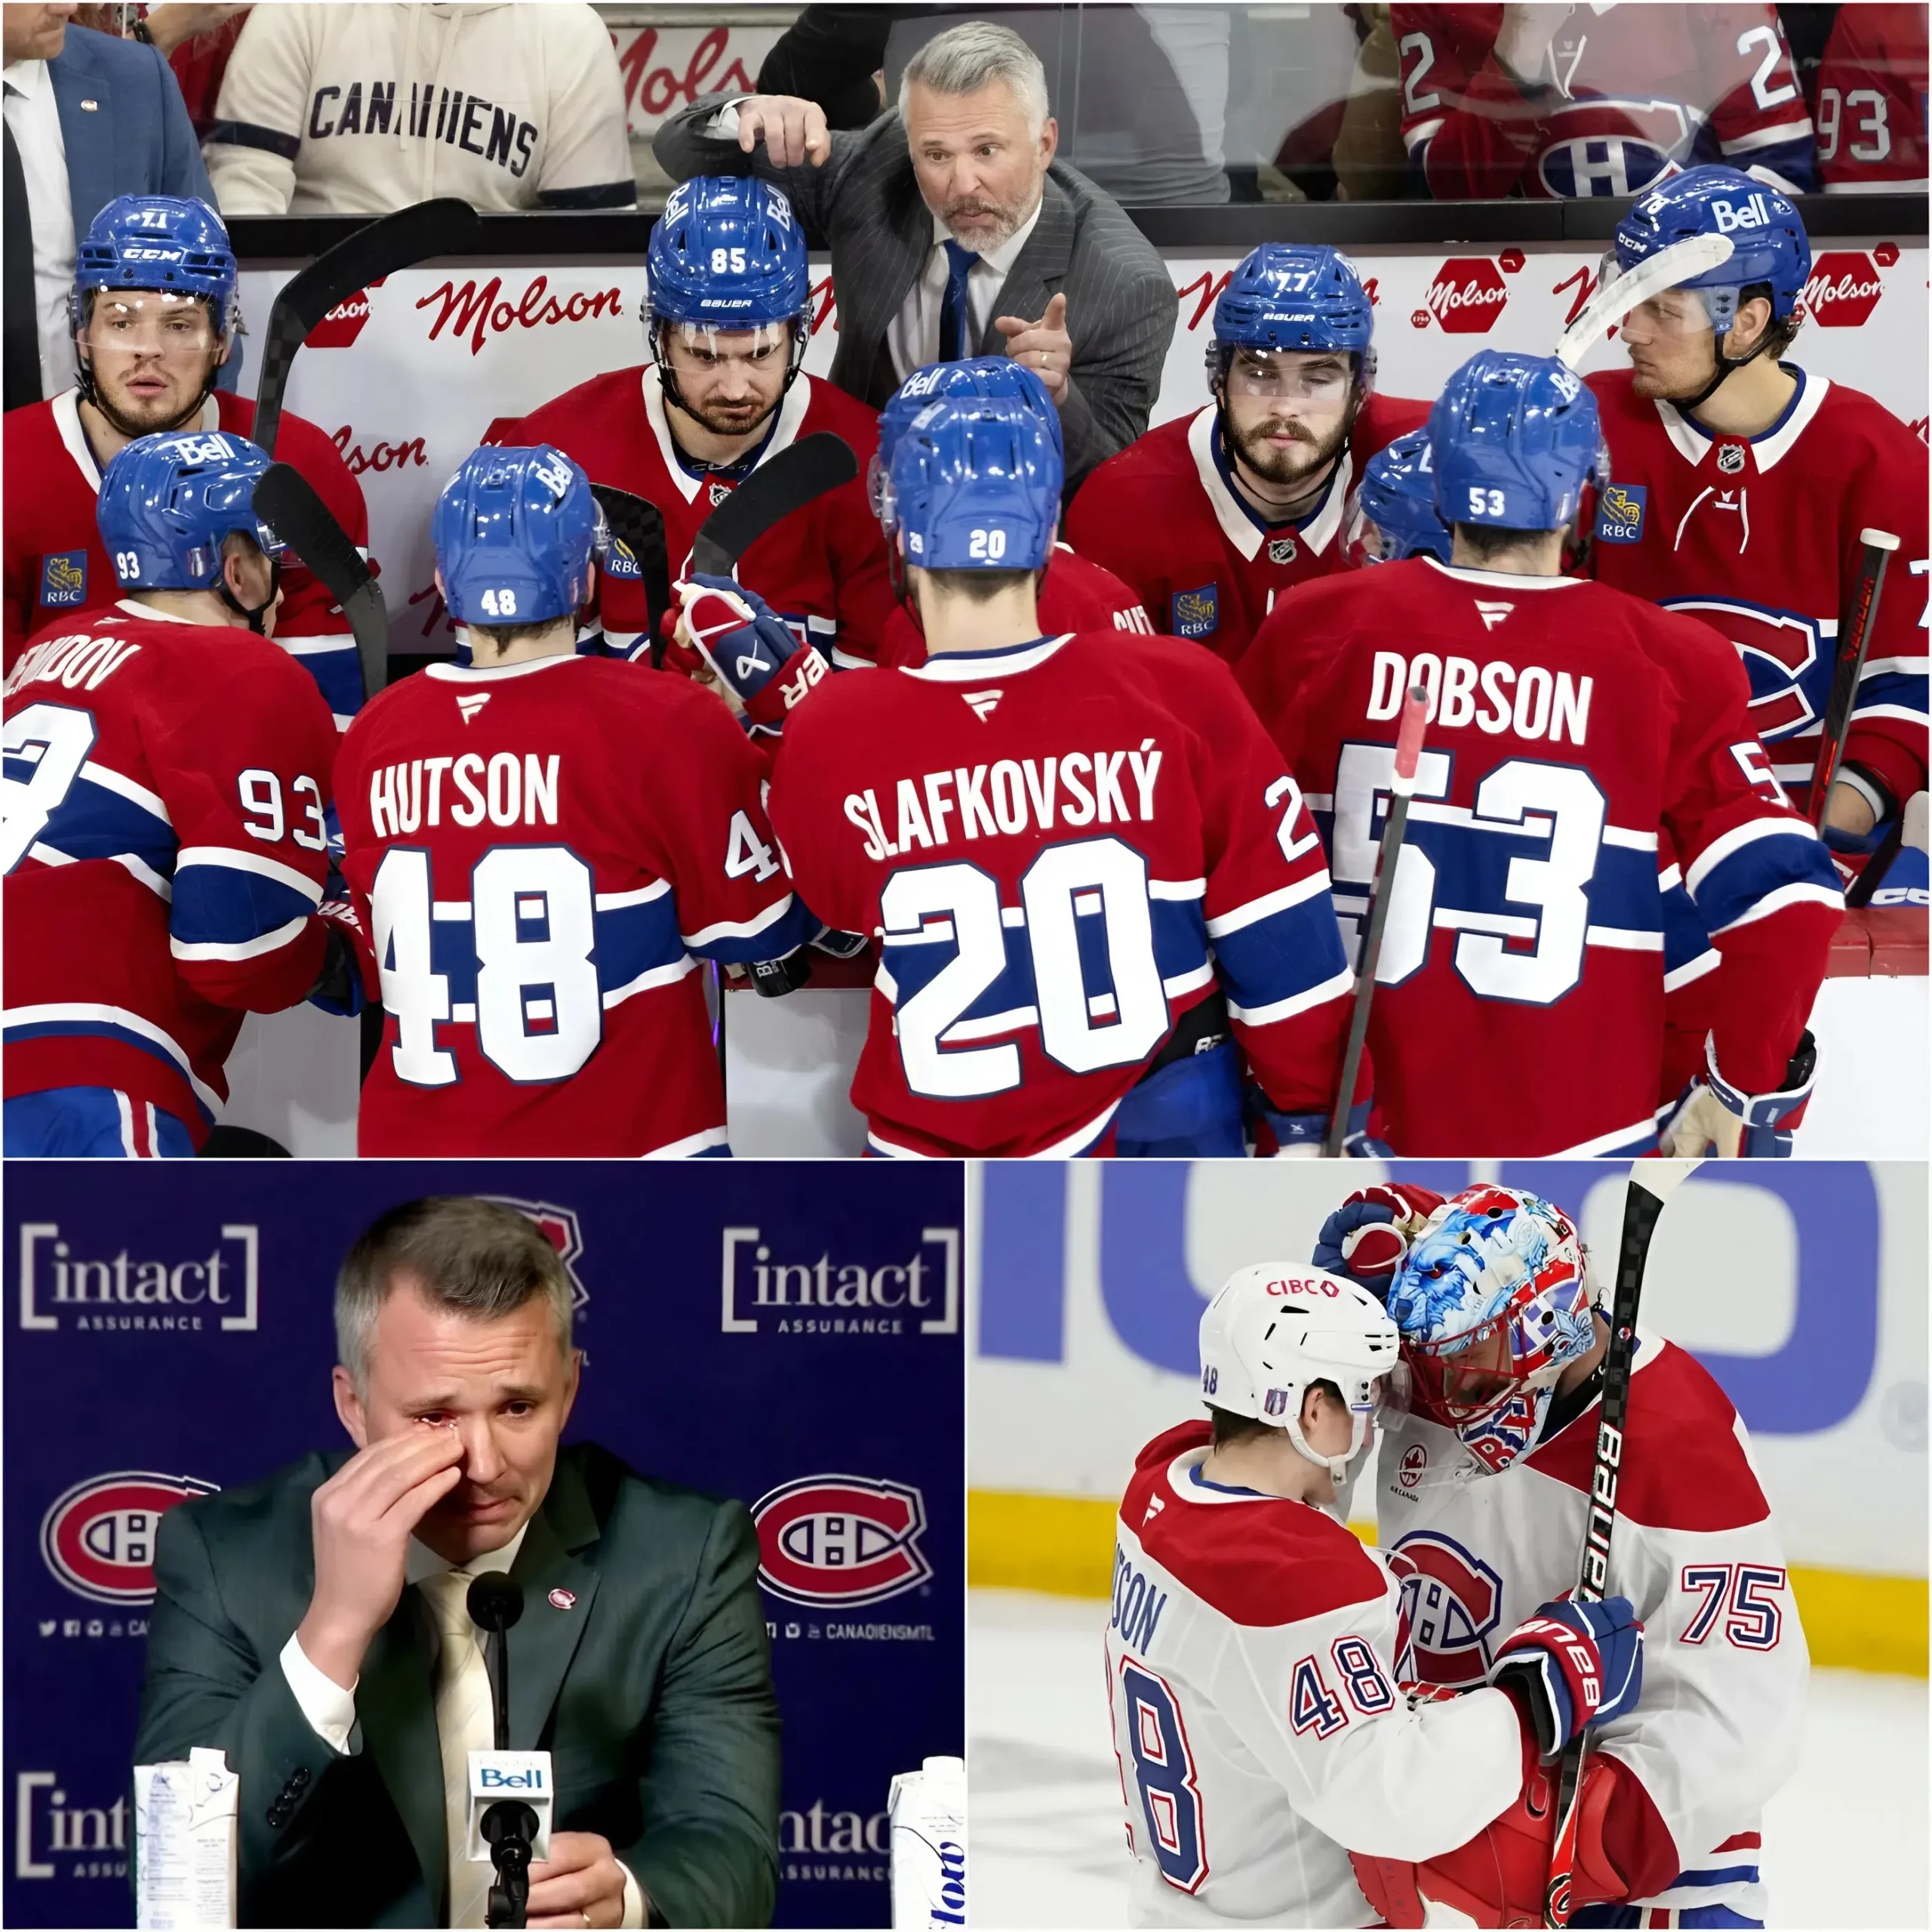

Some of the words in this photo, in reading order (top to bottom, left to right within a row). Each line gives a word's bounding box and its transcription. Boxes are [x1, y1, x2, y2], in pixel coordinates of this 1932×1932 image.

[1819, 88, 1891, 163] 93
[1712, 193, 1770, 233] Bell
[123, 248, 182, 261] CCM
[712, 248, 746, 274] 85
[700, 299, 753, 308] BAUER
[1426, 279, 1512, 319] Molson
[1795, 273, 1885, 313] Molson
[416, 275, 624, 356] Molson
[900, 368, 946, 399] Bell
[174, 433, 236, 466] Bell
[1469, 488, 1505, 516] 53
[969, 529, 1006, 558] 20
[1602, 524, 1636, 539] RBC
[116, 551, 140, 580] 93
[47, 590, 81, 603] RBC
[481, 589, 516, 616] 48
[1180, 623, 1215, 635] RBC
[1366, 651, 1594, 746] DOBSON
[237, 766, 328, 852] 93
[369, 752, 561, 839] HUTSON
[844, 738, 1163, 862] SLAFKOVSKÝ
[724, 777, 795, 884] 4
[1331, 737, 1609, 1008] 53
[371, 843, 604, 1089] 48
[878, 835, 1174, 1102] 20
[1266, 1279, 1318, 1297] CIBC
[77, 1316, 202, 1331] ASSURANCE
[777, 1318, 903, 1334] ASSURANCE
[1203, 1364, 1218, 1395] 48
[1679, 1563, 1786, 1652] 75
[1289, 1635, 1396, 1741] 48
[481, 1768, 542, 1789] Bell
[779, 1797, 892, 1854] ntac
[780, 1863, 892, 1881] SSURANC
[931, 1841, 965, 1925] low
